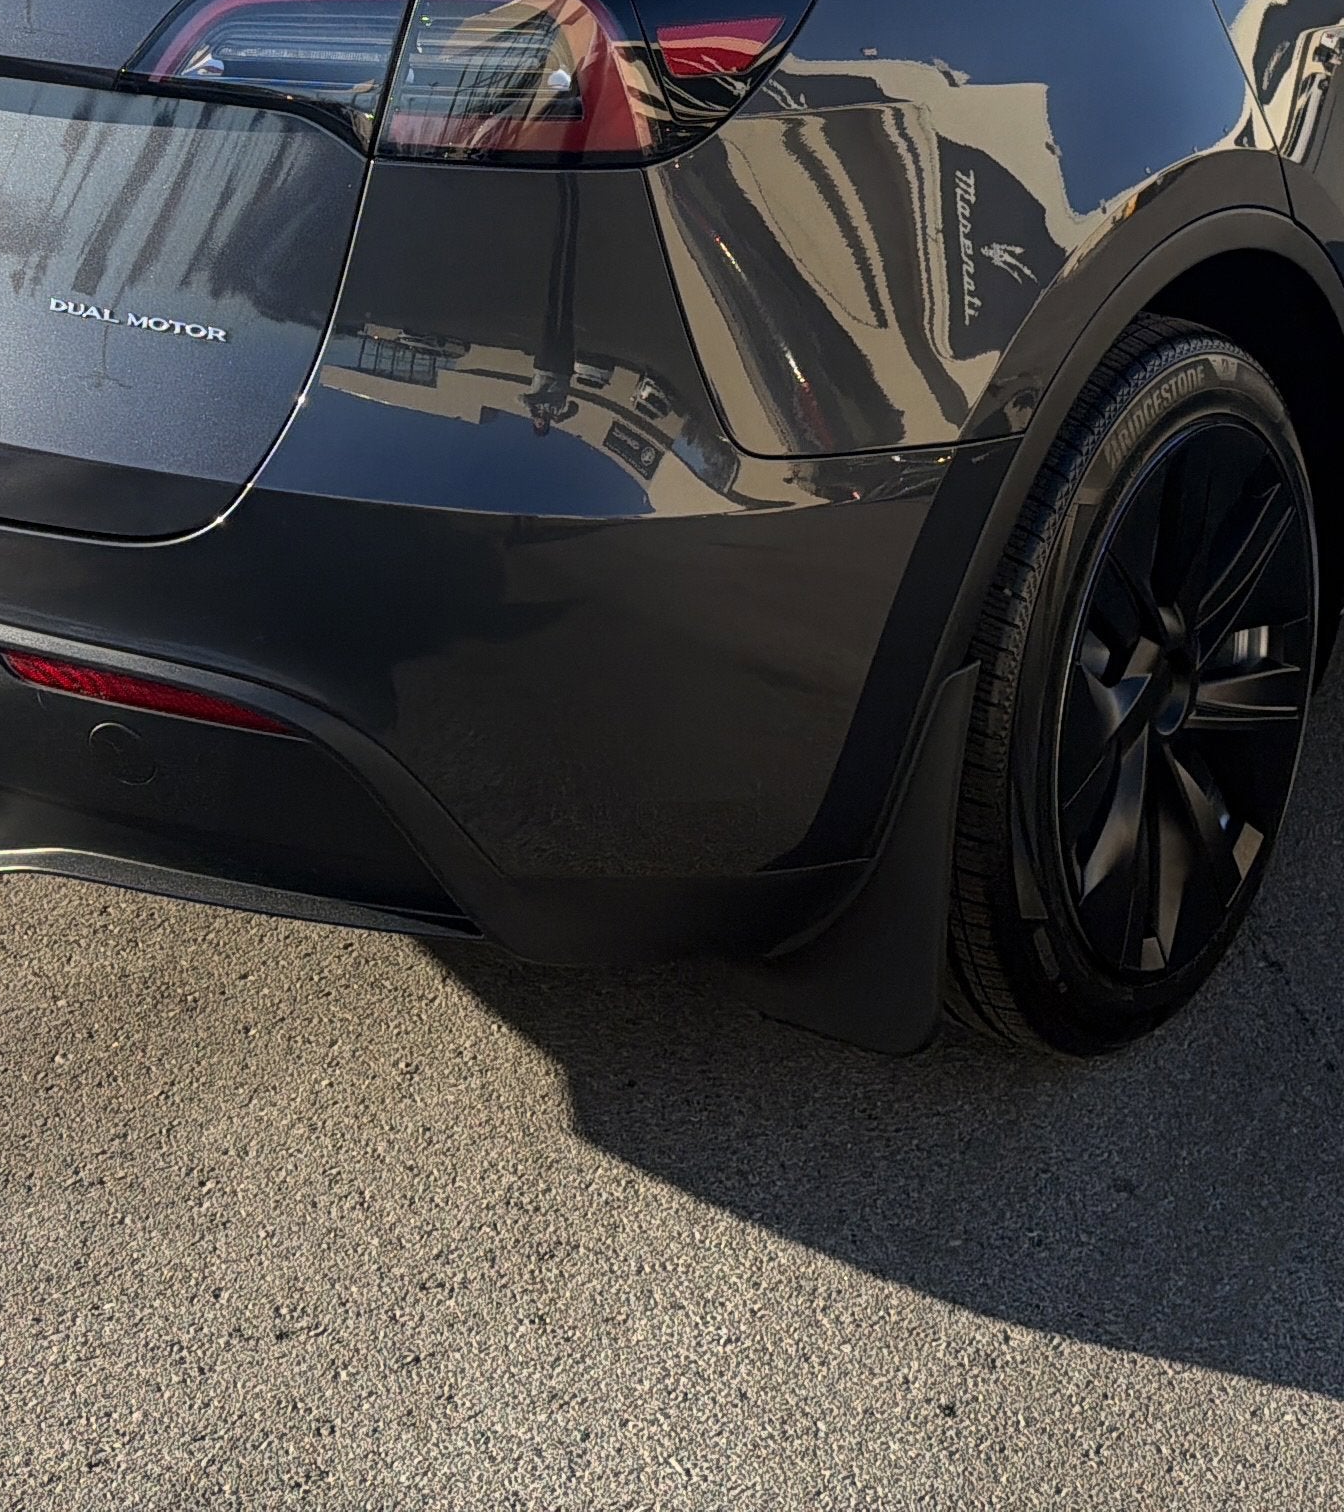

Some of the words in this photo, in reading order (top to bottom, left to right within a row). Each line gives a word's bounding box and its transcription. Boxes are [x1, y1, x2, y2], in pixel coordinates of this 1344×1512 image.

[954, 169, 983, 326] Maserati
[49, 297, 121, 325] DUAL
[127, 311, 228, 344] MOTOR
